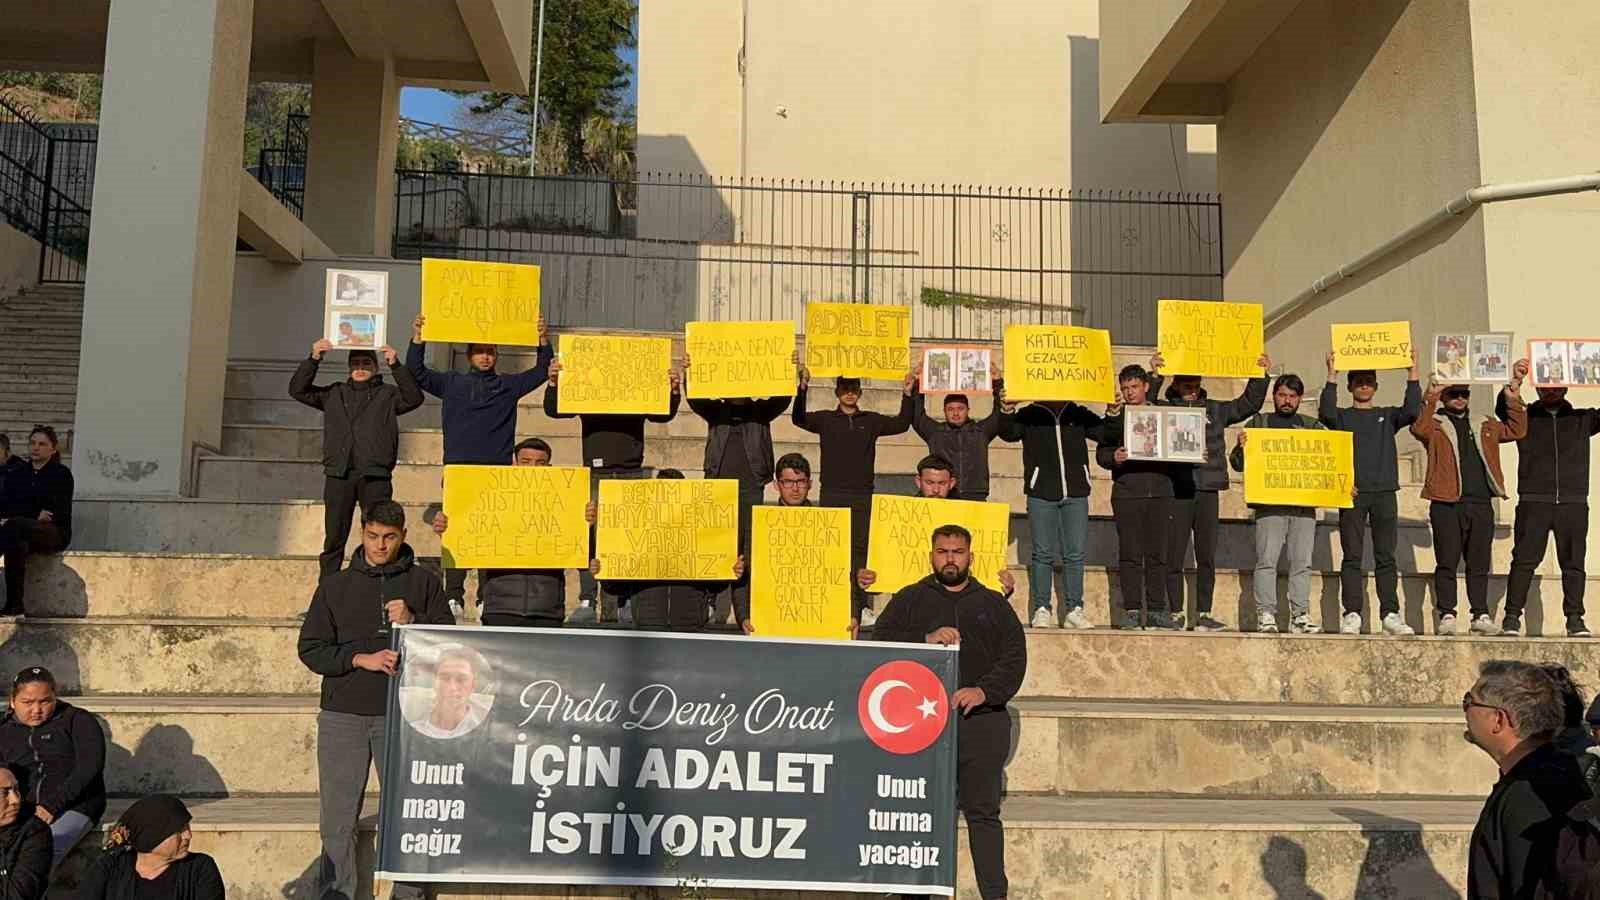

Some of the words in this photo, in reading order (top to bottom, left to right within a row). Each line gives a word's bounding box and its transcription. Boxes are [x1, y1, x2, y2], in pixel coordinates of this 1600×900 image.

[808, 309, 911, 338] ADALET
[1025, 330, 1089, 350] KATİLLER
[1344, 330, 1391, 343] ADALETE
[1025, 352, 1079, 365] CEZASIZ
[689, 360, 718, 384] HEP
[488, 468, 554, 490] SUSMA
[691, 481, 714, 504] DE
[519, 512, 562, 536] SANA
[888, 524, 930, 549] ARDA
[519, 679, 621, 728] Arda
[621, 683, 740, 745] Deniz
[744, 688, 835, 735] Onat
[410, 760, 465, 785] Unut
[511, 733, 622, 798] İÇİN
[635, 747, 834, 793] ADALET
[877, 774, 927, 799] Unut
[402, 798, 465, 822] maya
[868, 808, 932, 833] turma
[400, 827, 462, 857] cağız
[529, 800, 808, 860] İSTİYORUZ
[858, 840, 940, 869] yacağız
